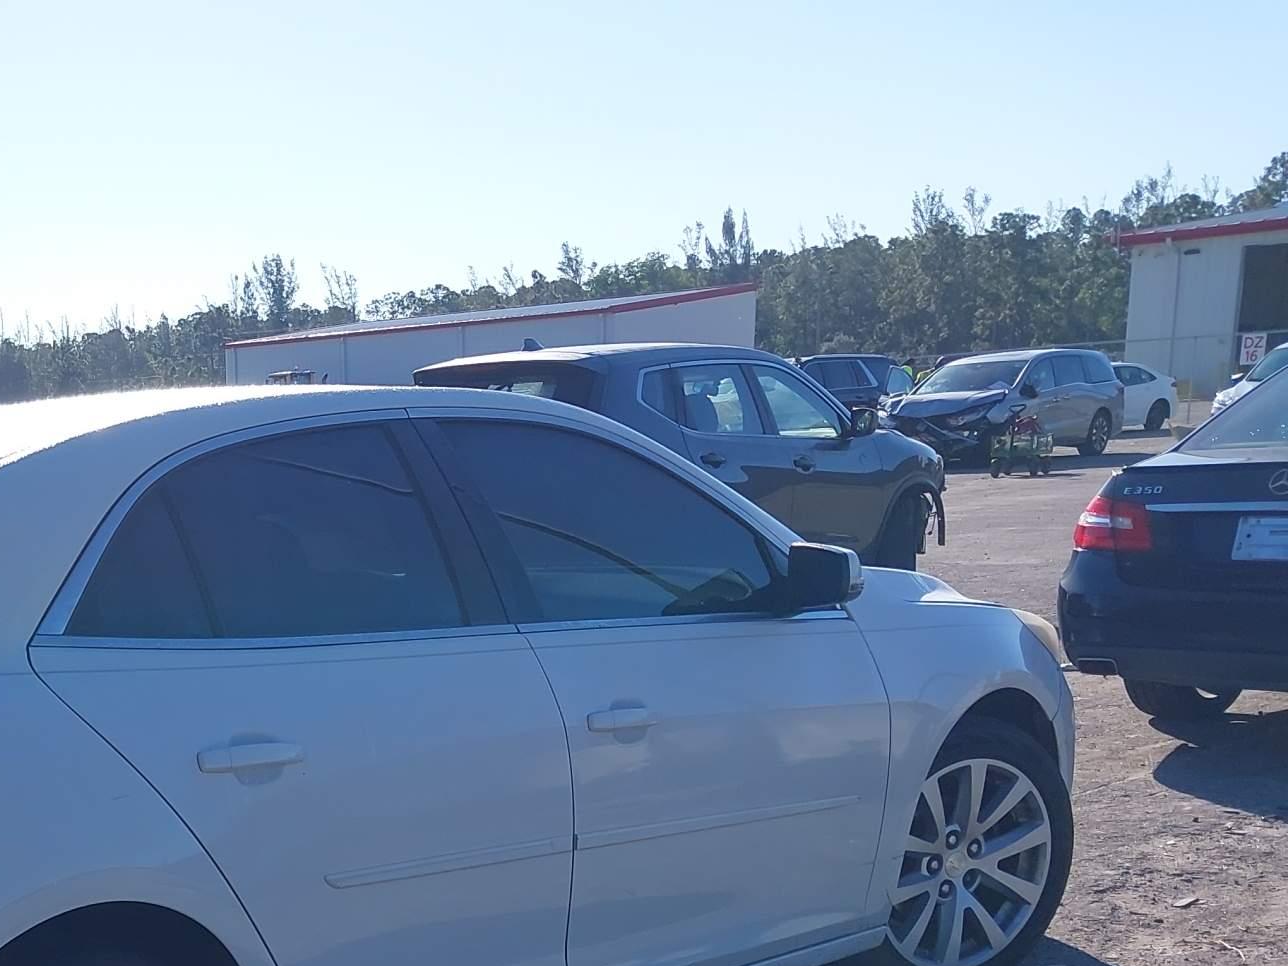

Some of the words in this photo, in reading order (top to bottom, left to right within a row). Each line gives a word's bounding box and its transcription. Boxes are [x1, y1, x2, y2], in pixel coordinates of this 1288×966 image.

[1244, 336, 1264, 349] DZ
[1245, 350, 1258, 362] 16
[1123, 486, 1163, 495] E350
